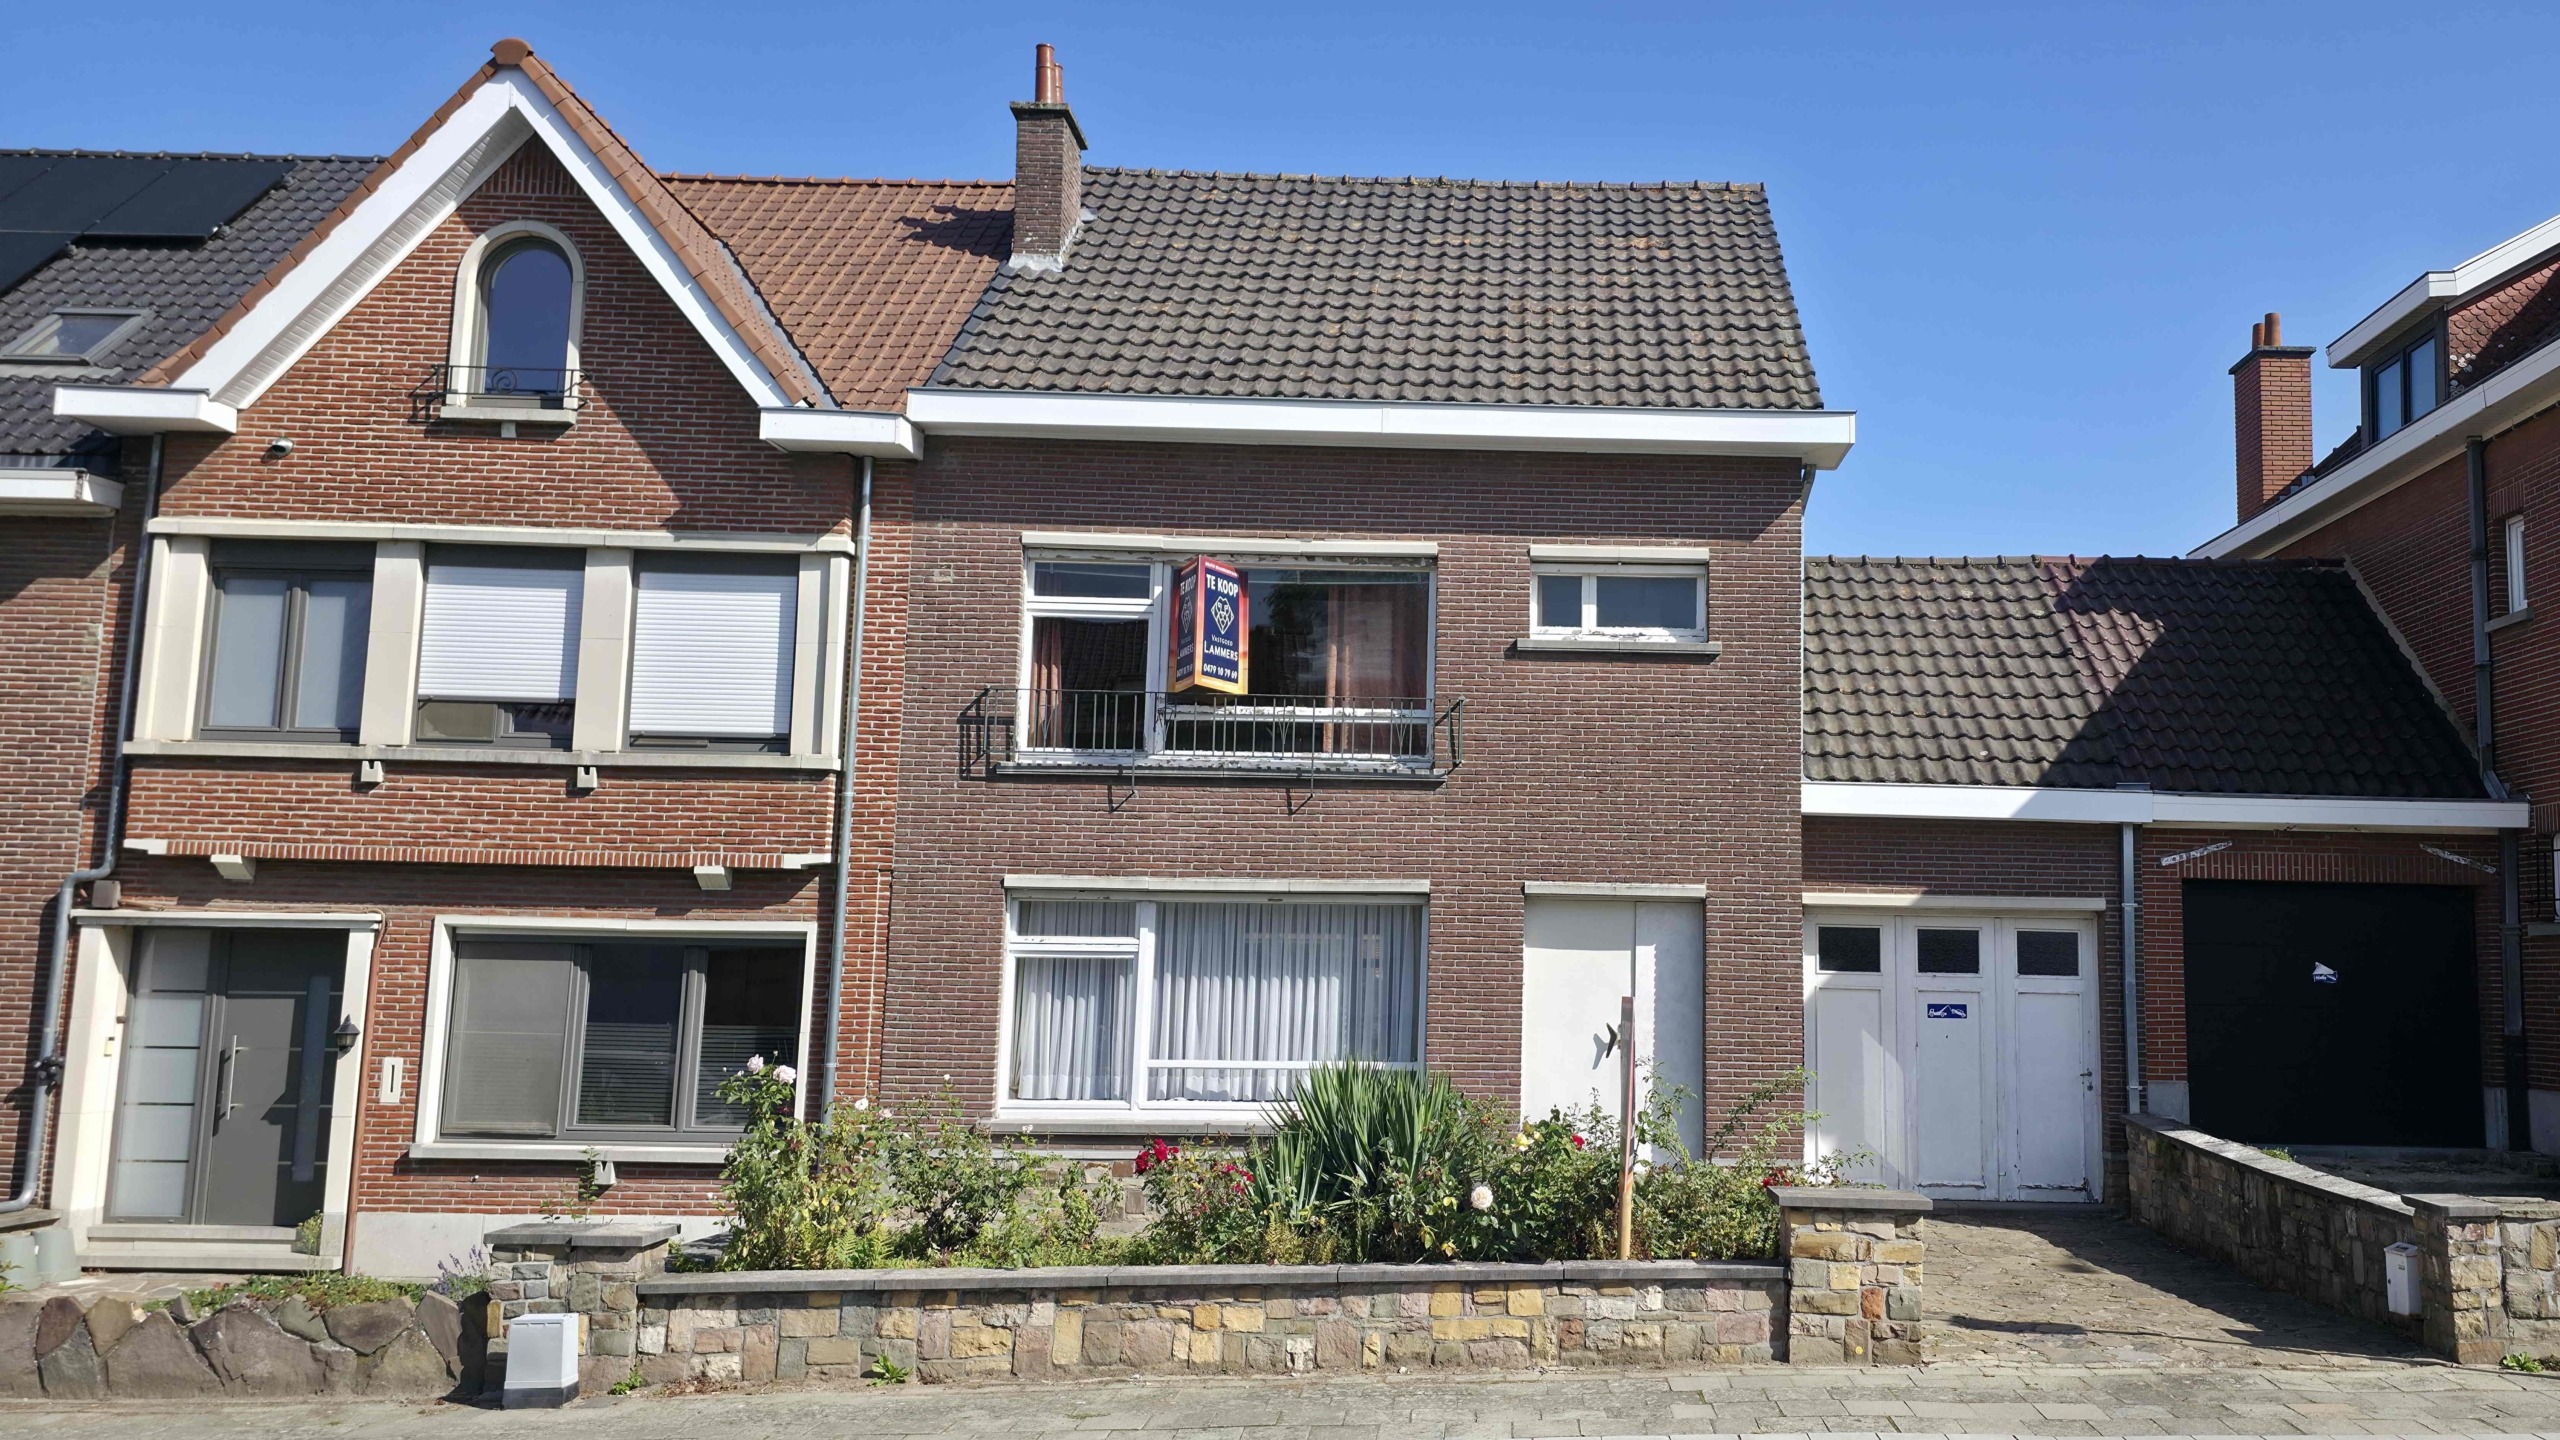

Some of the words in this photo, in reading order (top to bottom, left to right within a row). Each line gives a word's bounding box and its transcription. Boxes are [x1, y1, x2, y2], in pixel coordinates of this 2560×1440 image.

[1206, 573, 1216, 590] TE
[1217, 577, 1239, 597] KOOP
[1204, 640, 1239, 661] LAMMERS
[1203, 663, 1217, 674] 0479
